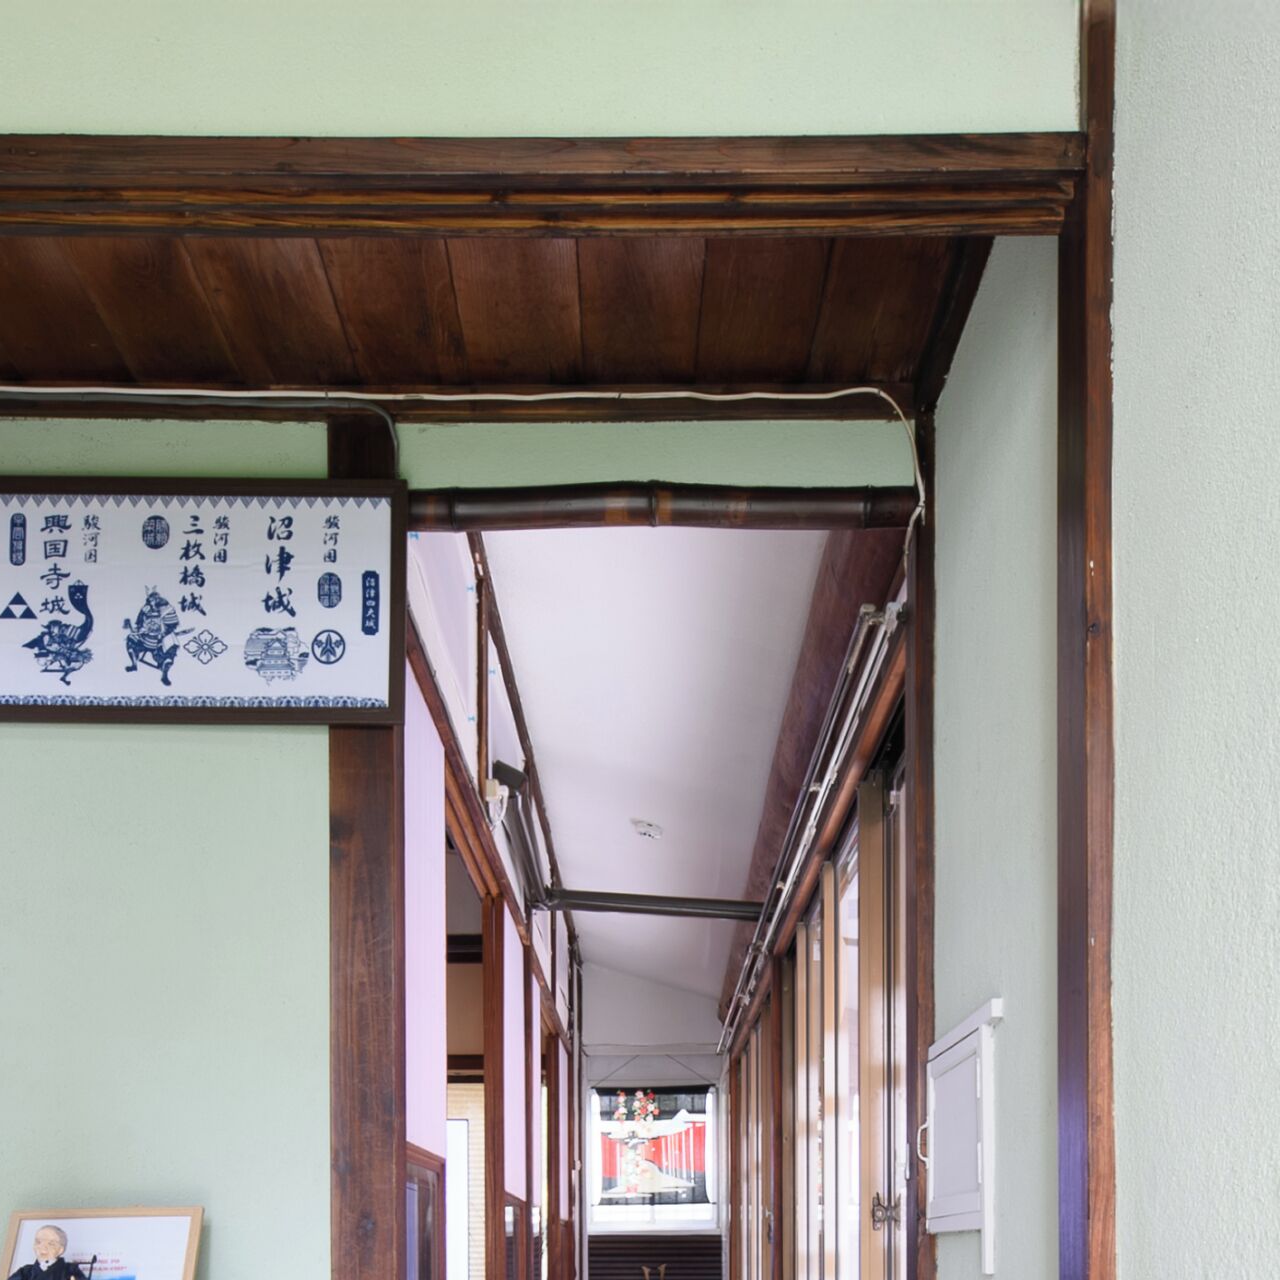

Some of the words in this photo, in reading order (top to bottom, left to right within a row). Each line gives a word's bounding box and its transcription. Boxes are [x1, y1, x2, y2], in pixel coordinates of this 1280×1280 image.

[40, 514, 72, 615] 興国寺城
[178, 515, 207, 616] 三枚橋城
[261, 515, 297, 617] 沼津城
